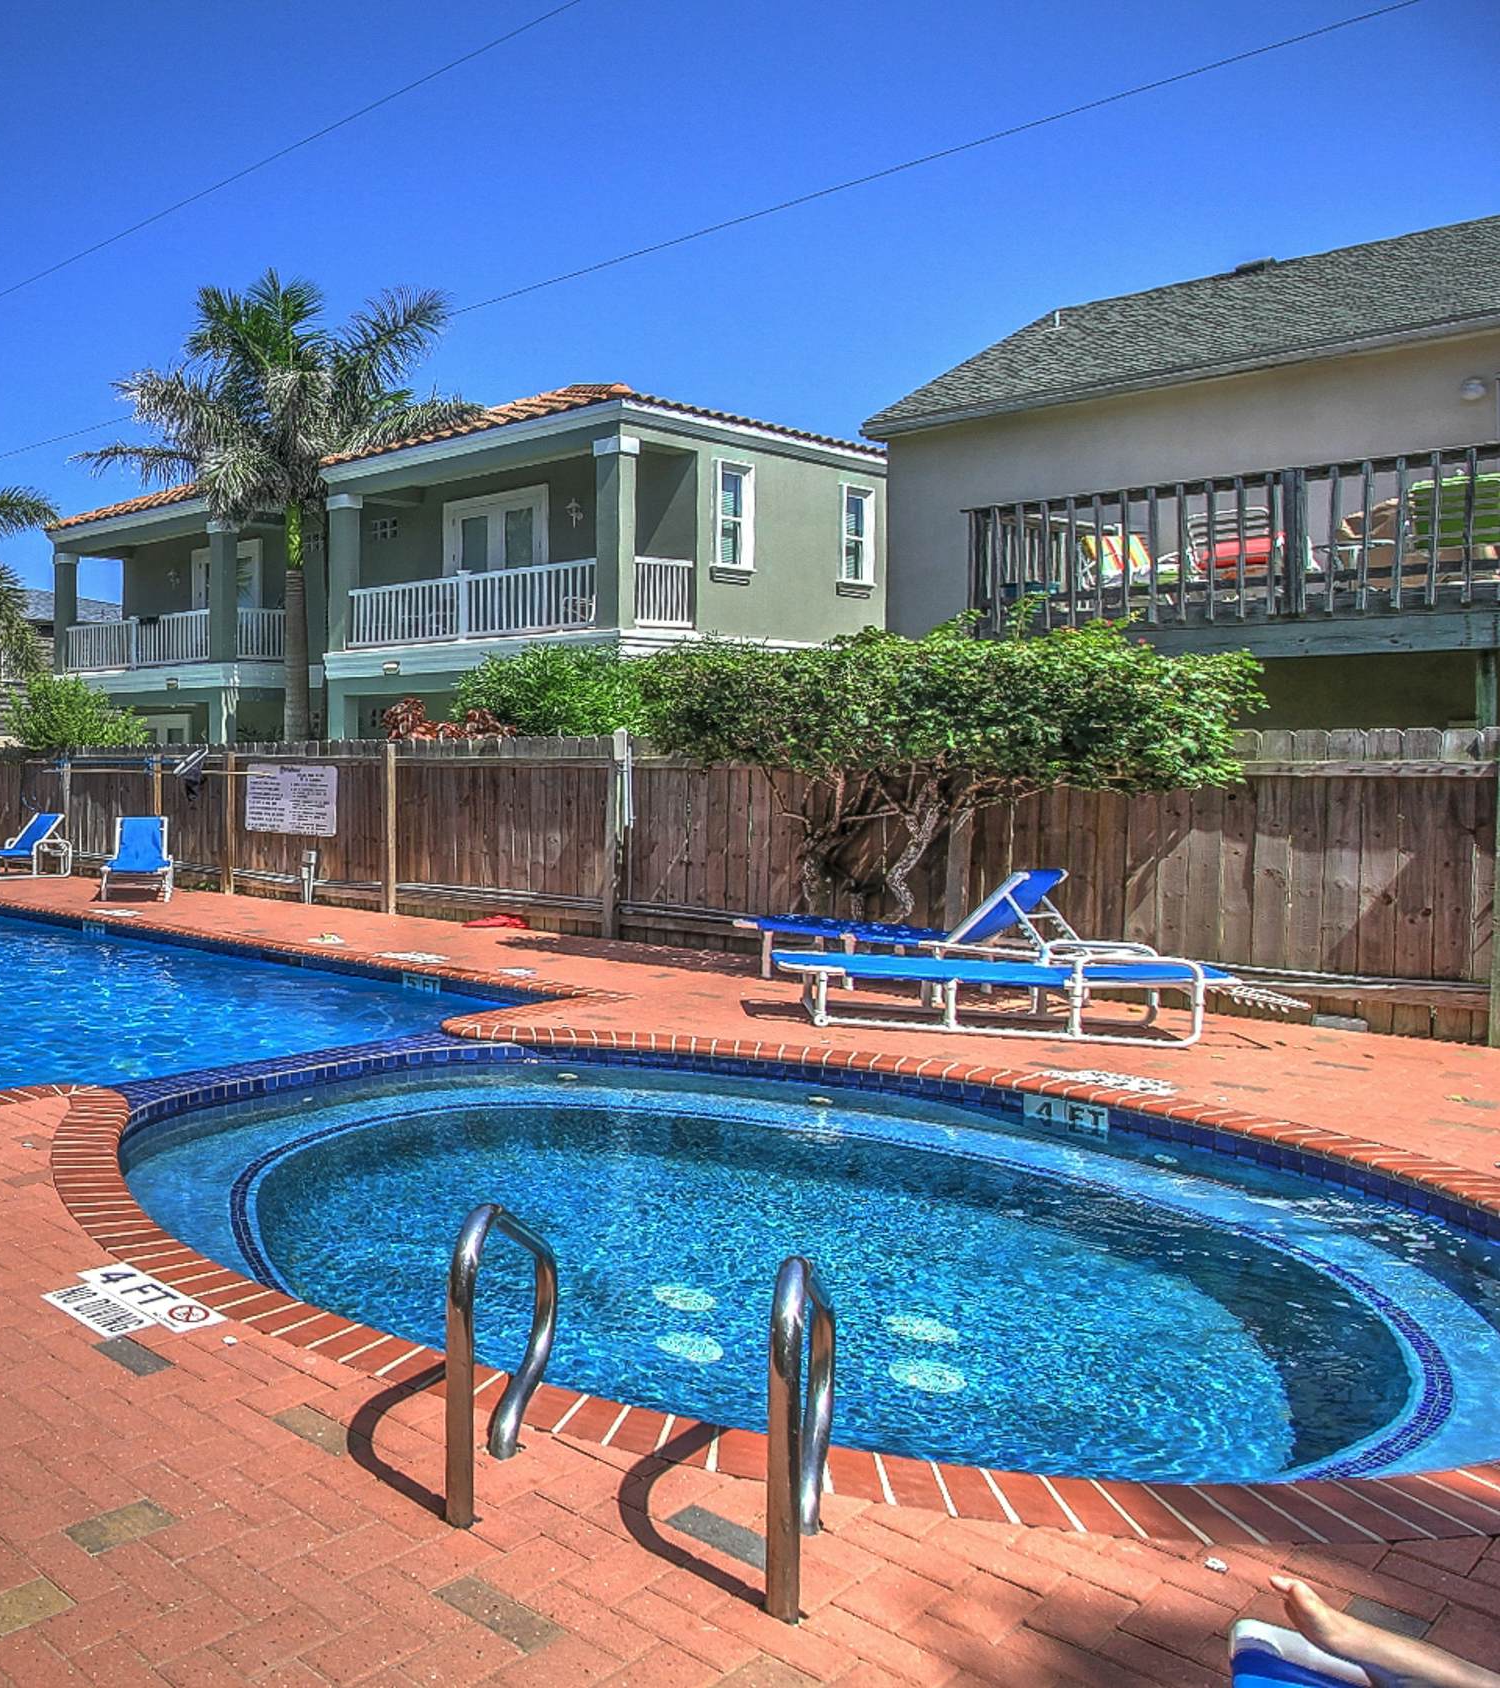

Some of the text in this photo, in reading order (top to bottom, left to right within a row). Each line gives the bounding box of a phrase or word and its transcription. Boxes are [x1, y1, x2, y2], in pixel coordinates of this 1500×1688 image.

[422, 978, 438, 992] FT
[1036, 1101, 1105, 1126] 4 FT
[100, 1272, 180, 1306] 4 FT
[73, 1298, 145, 1333] DIVING
